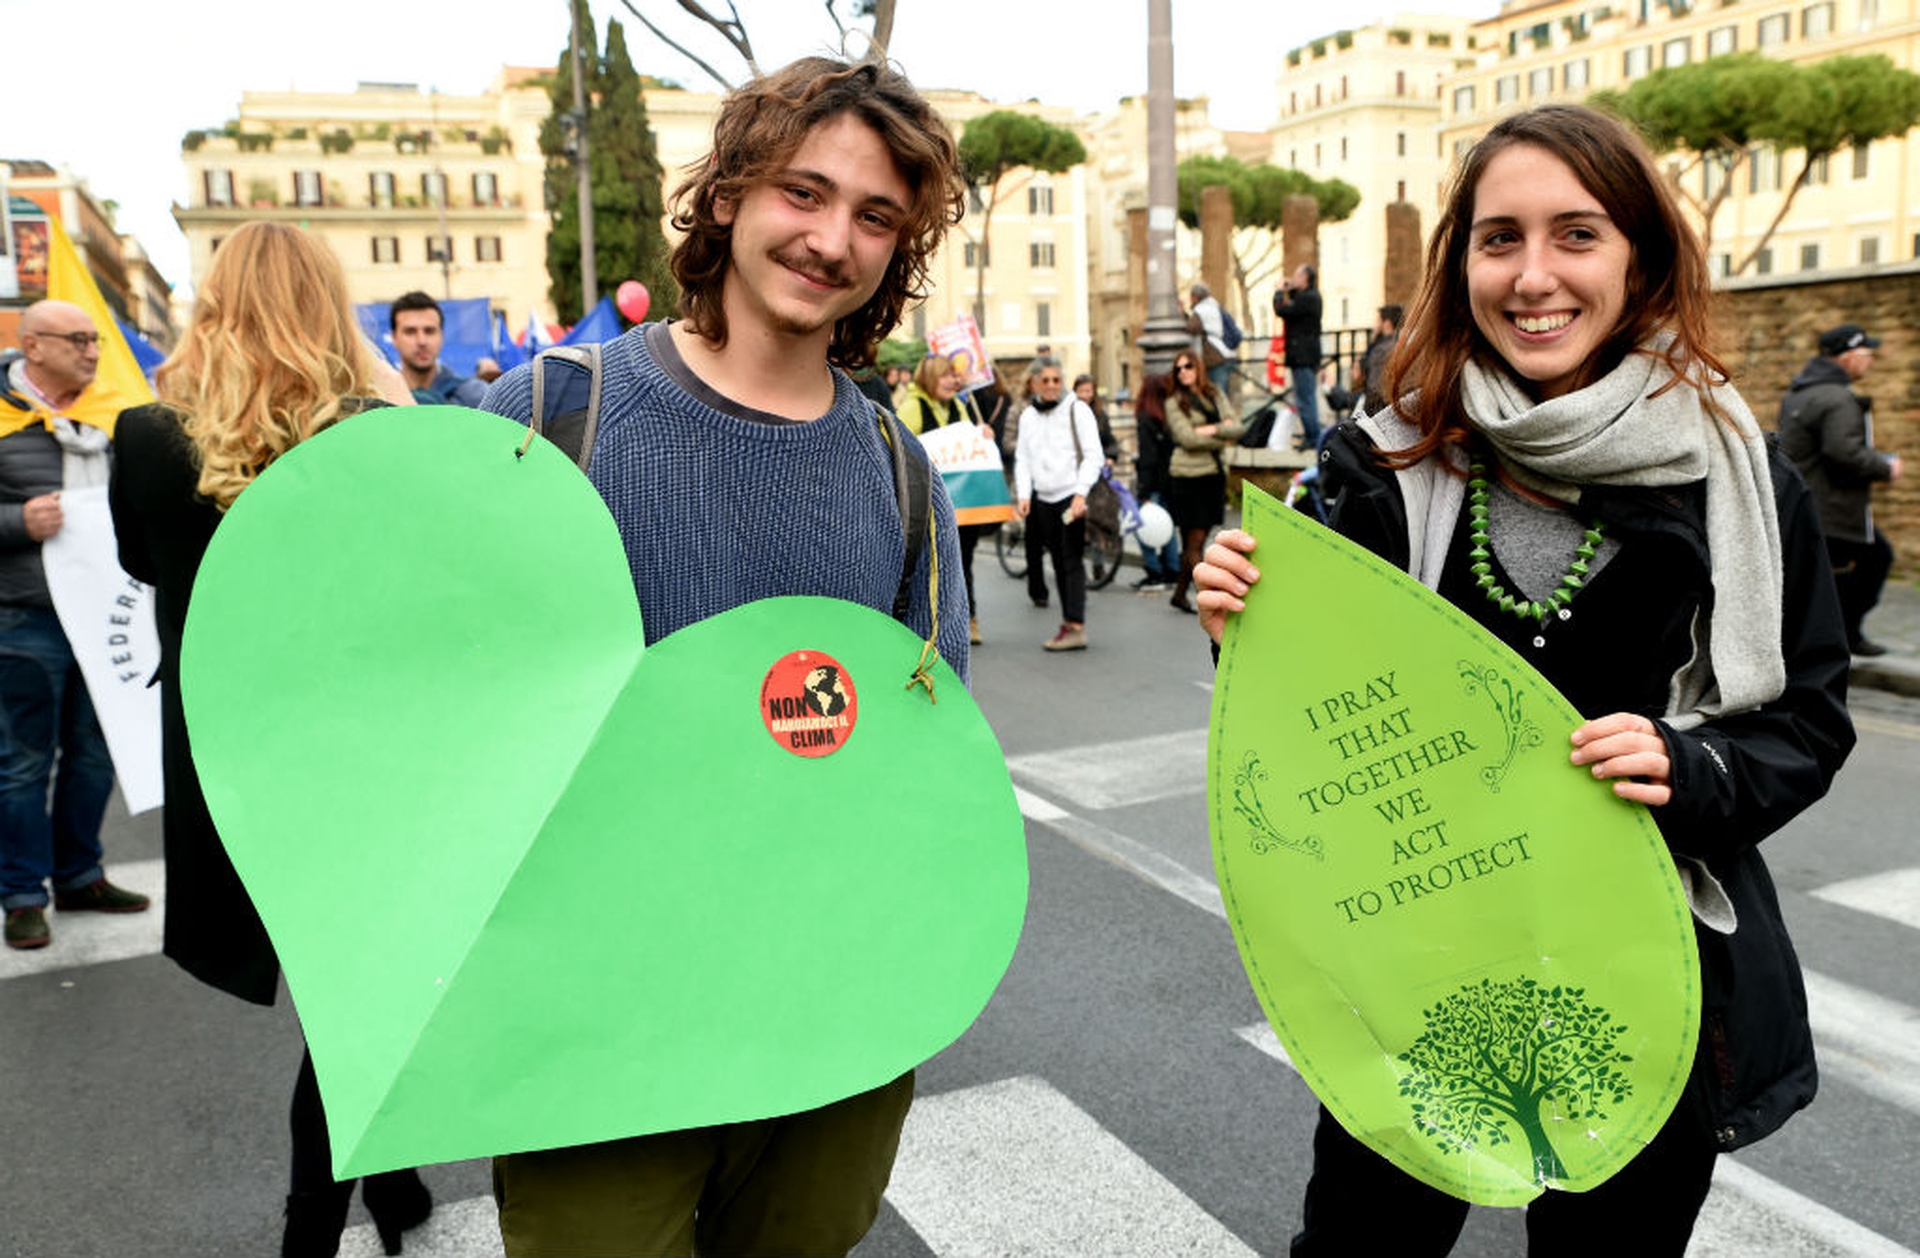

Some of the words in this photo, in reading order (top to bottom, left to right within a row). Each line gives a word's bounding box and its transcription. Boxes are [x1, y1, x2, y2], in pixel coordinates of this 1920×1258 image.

[769, 697, 807, 720] NON
[1305, 707, 1320, 732] I
[1323, 671, 1400, 724] PRAY
[790, 729, 836, 749] CLIMA
[1329, 707, 1415, 760] THAT
[1299, 730, 1479, 815] TOGETHER
[1374, 788, 1432, 824] WE
[1392, 820, 1451, 865] ACT
[1335, 890, 1383, 924] TO
[1385, 833, 1532, 906] PROTECT
